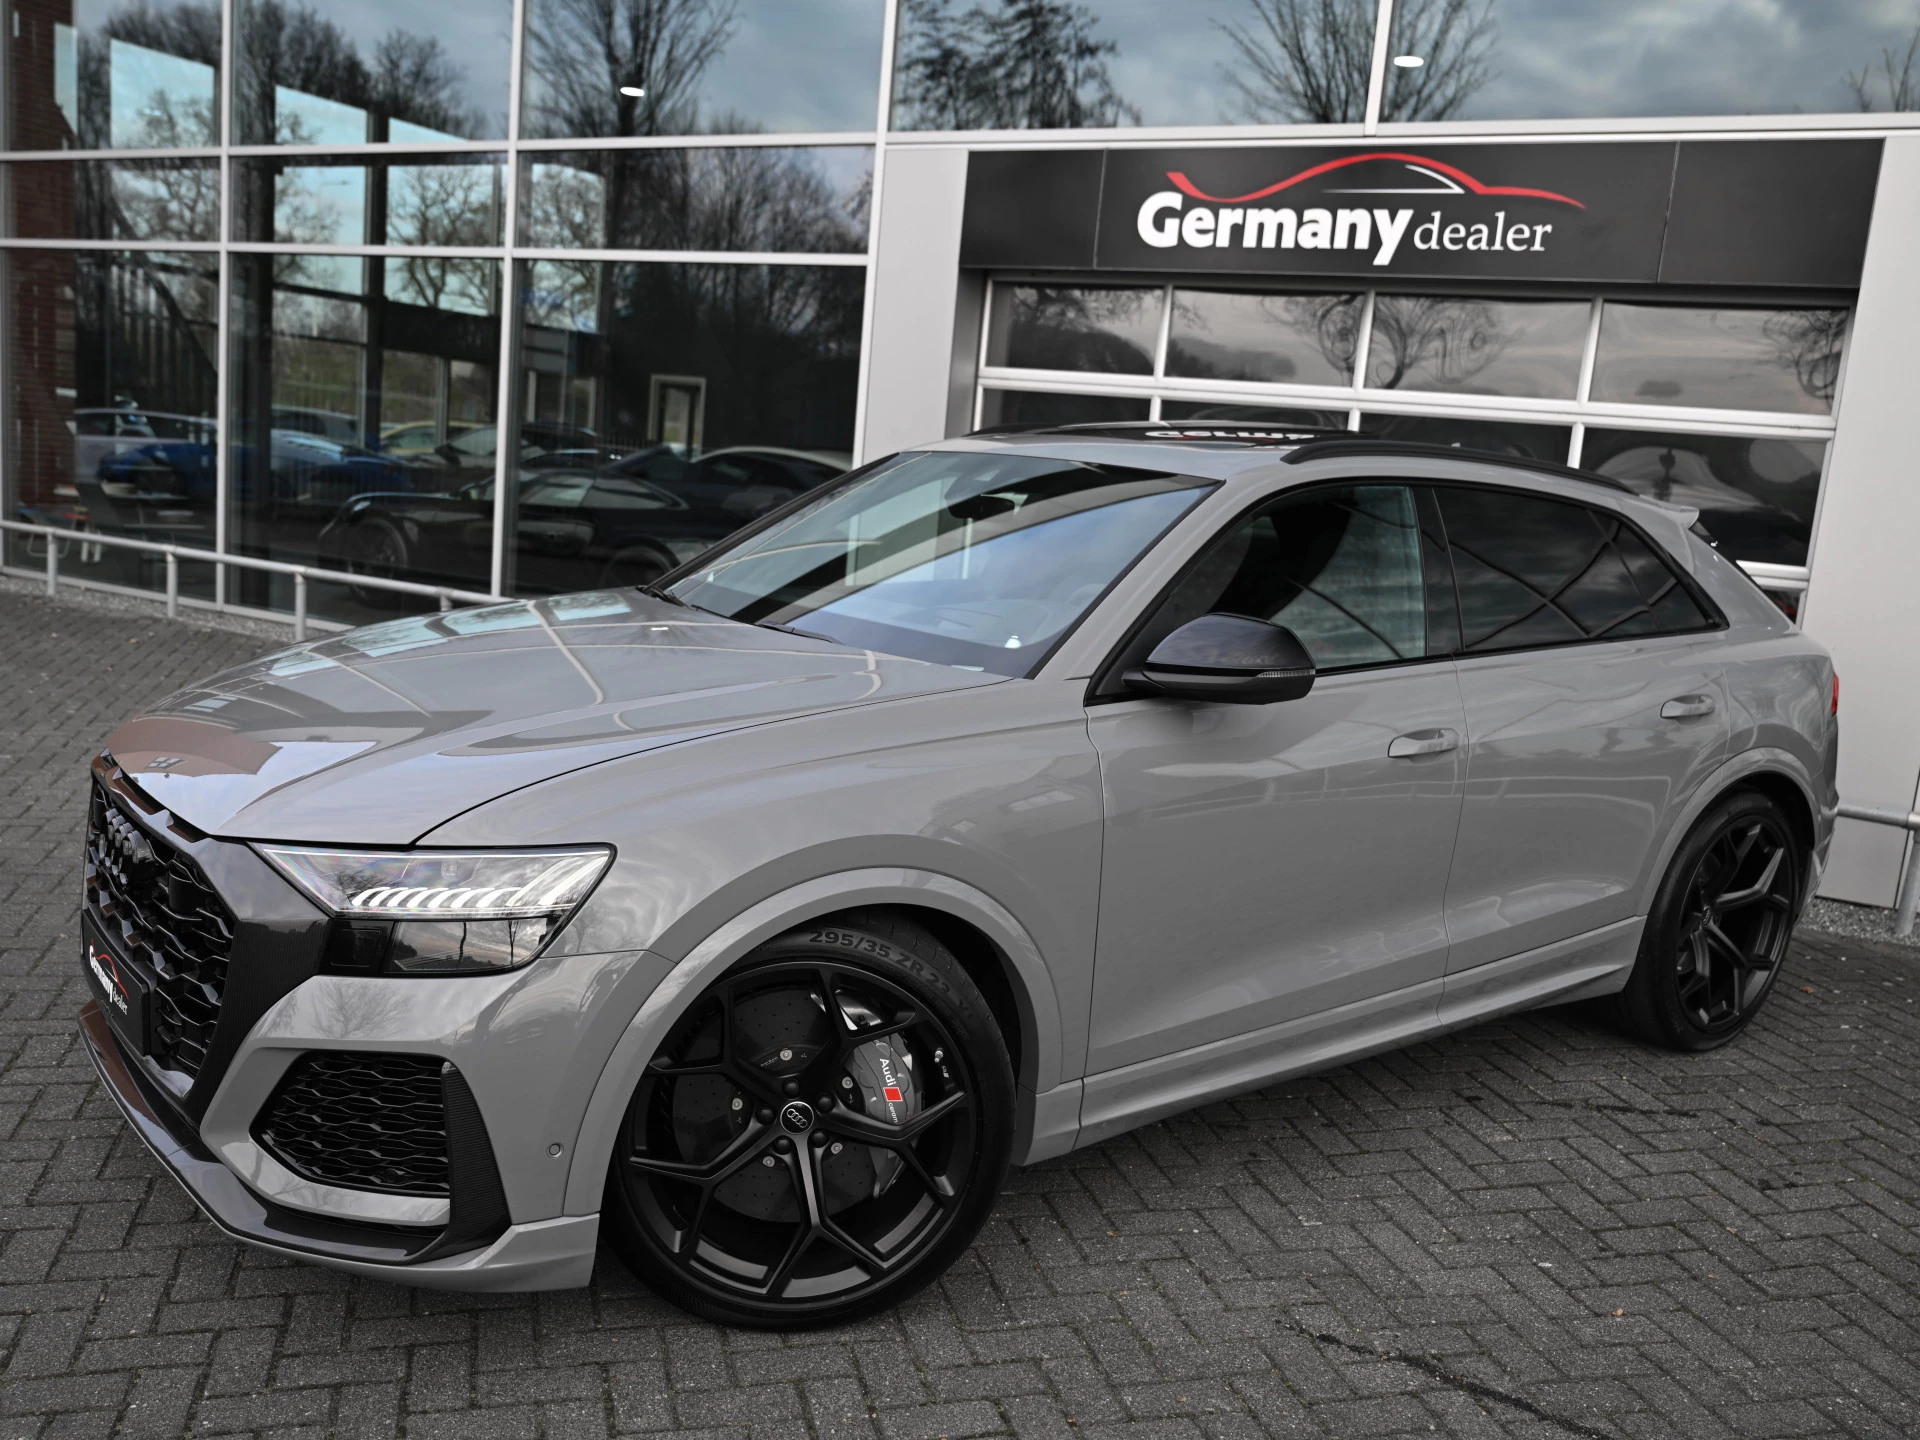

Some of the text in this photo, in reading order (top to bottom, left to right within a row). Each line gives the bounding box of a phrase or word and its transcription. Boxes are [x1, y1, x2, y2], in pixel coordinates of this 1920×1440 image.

[1137, 192, 1552, 265] Germany dealer
[809, 931, 950, 993] 295/35 ZR 23
[880, 1058, 896, 1086] Audi
[889, 1102, 898, 1123] ceram
